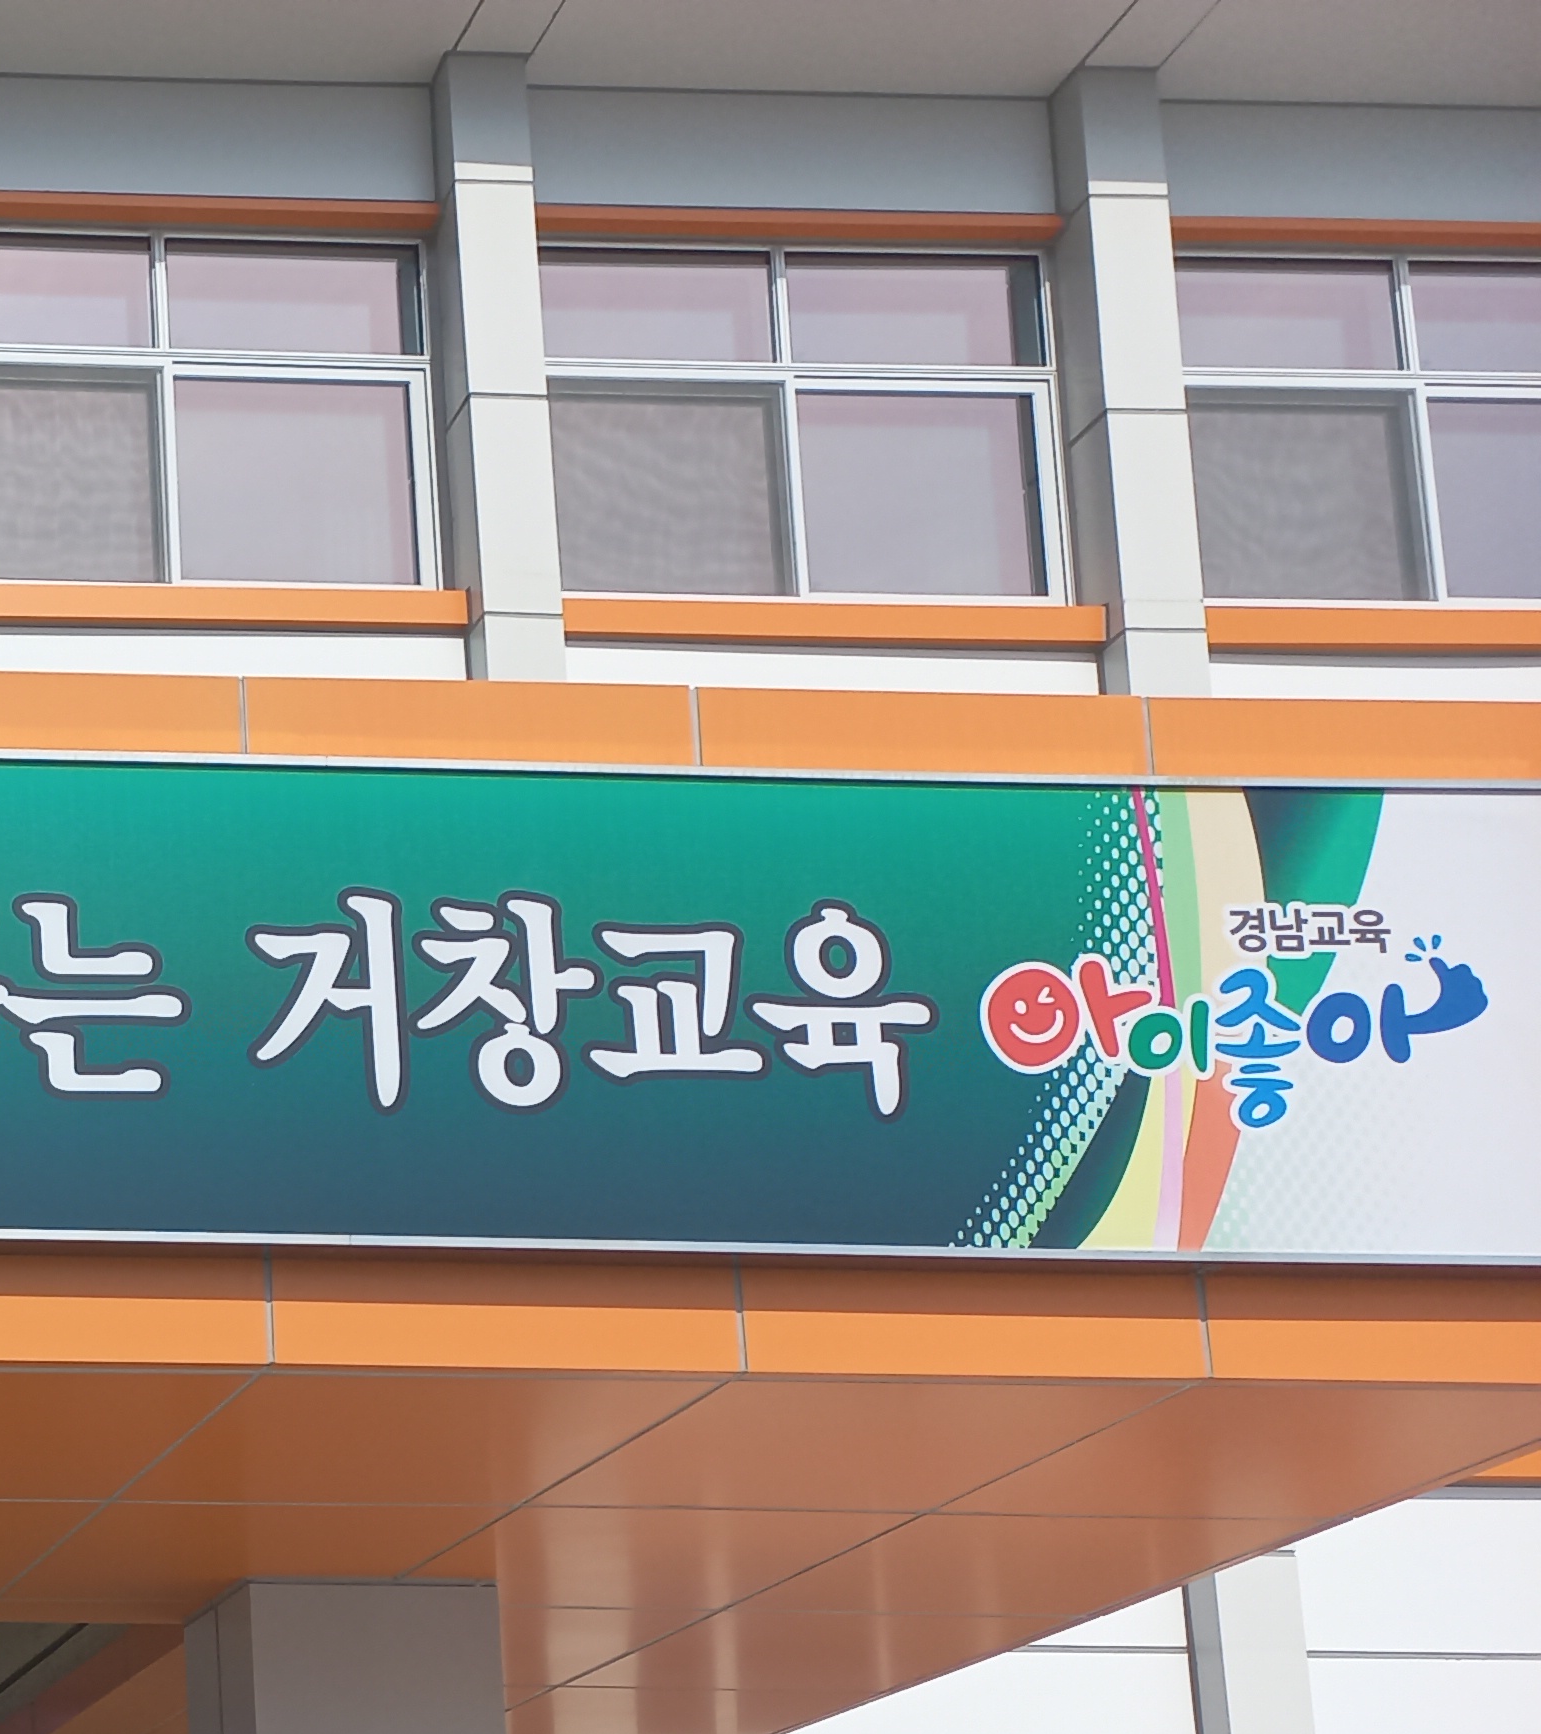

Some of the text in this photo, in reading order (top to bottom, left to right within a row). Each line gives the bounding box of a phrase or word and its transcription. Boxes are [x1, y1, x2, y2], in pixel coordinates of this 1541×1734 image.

[249, 888, 935, 1118] 거창교육
[1229, 908, 1391, 953] 경남교육
[986, 957, 1488, 1128] 아이좋아
